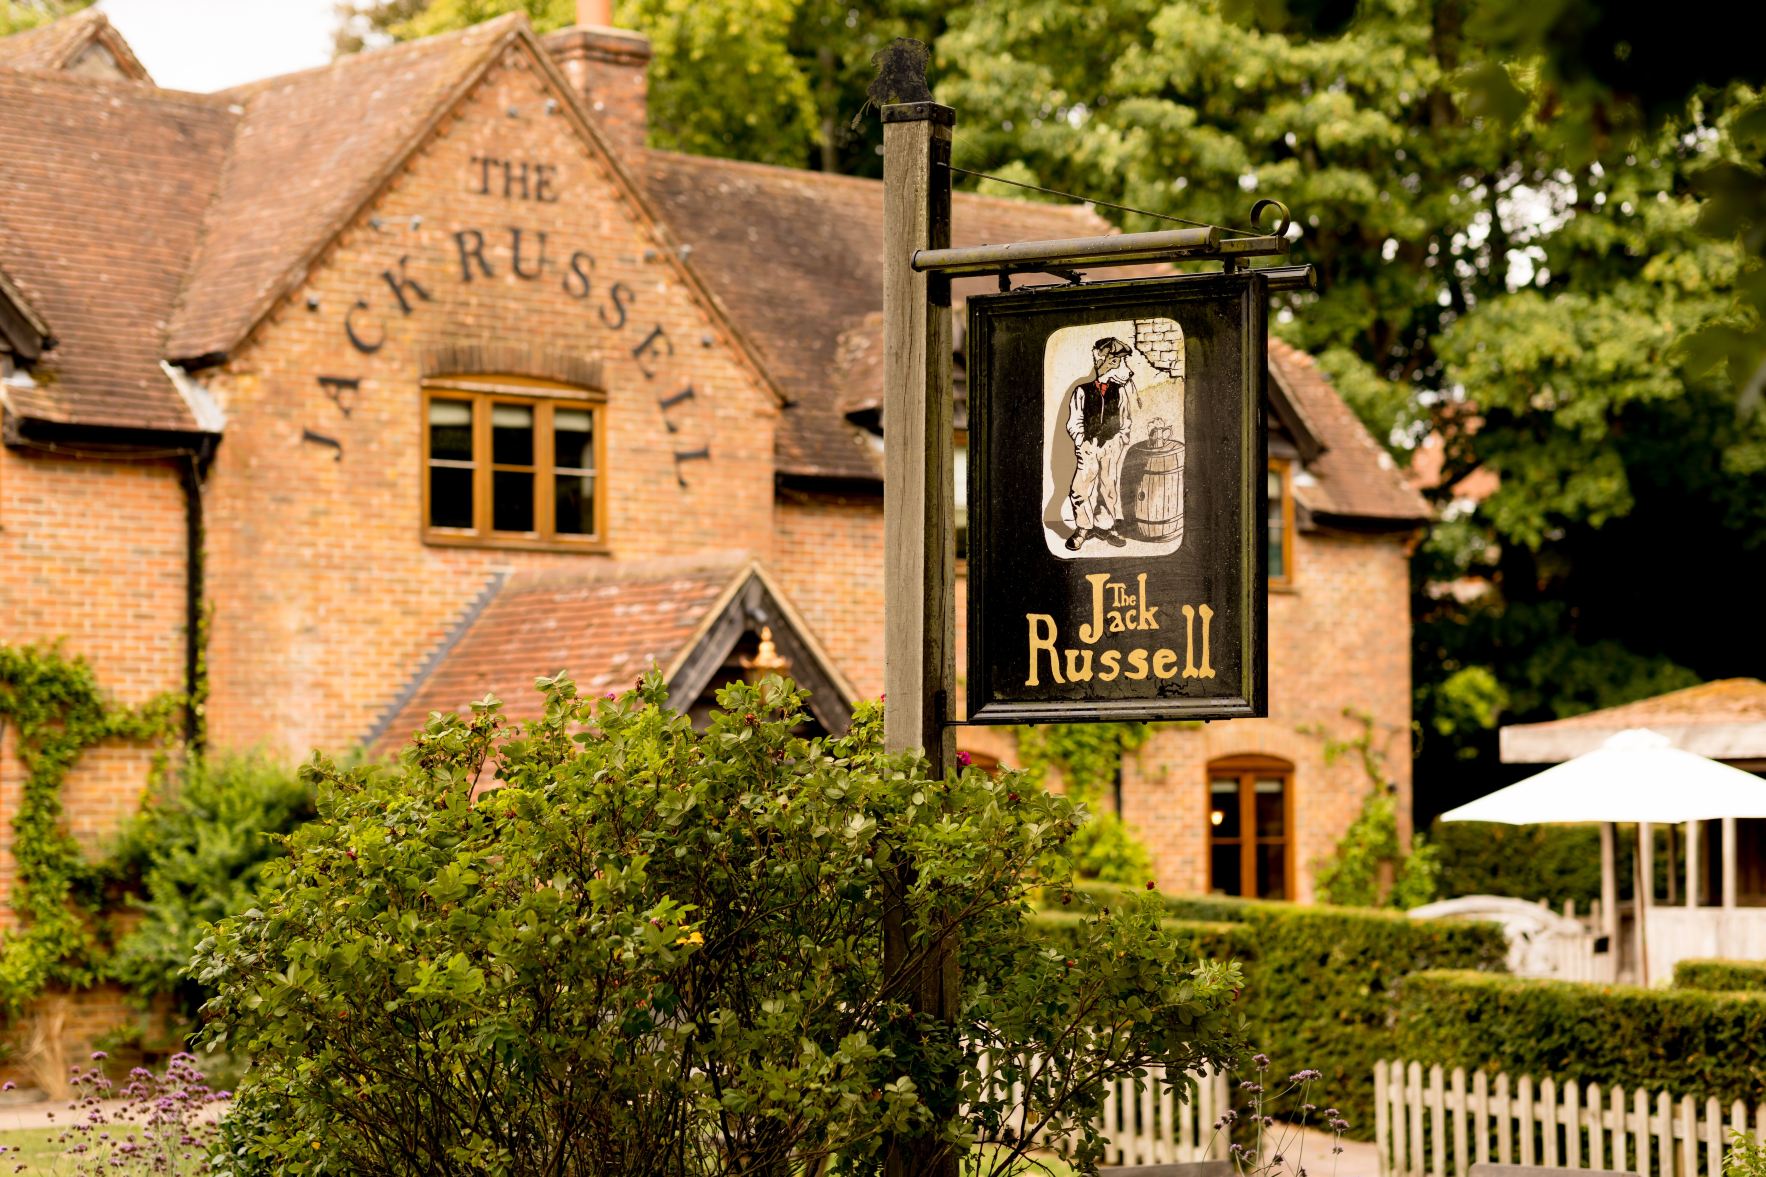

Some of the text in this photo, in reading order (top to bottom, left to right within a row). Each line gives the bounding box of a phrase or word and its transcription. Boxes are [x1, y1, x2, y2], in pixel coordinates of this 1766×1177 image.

[470, 155, 558, 202] THE
[303, 227, 710, 488] JACK RUSSELL
[1078, 572, 1160, 644] Jack
[1105, 582, 1136, 607] The
[1025, 603, 1216, 686] Russell
